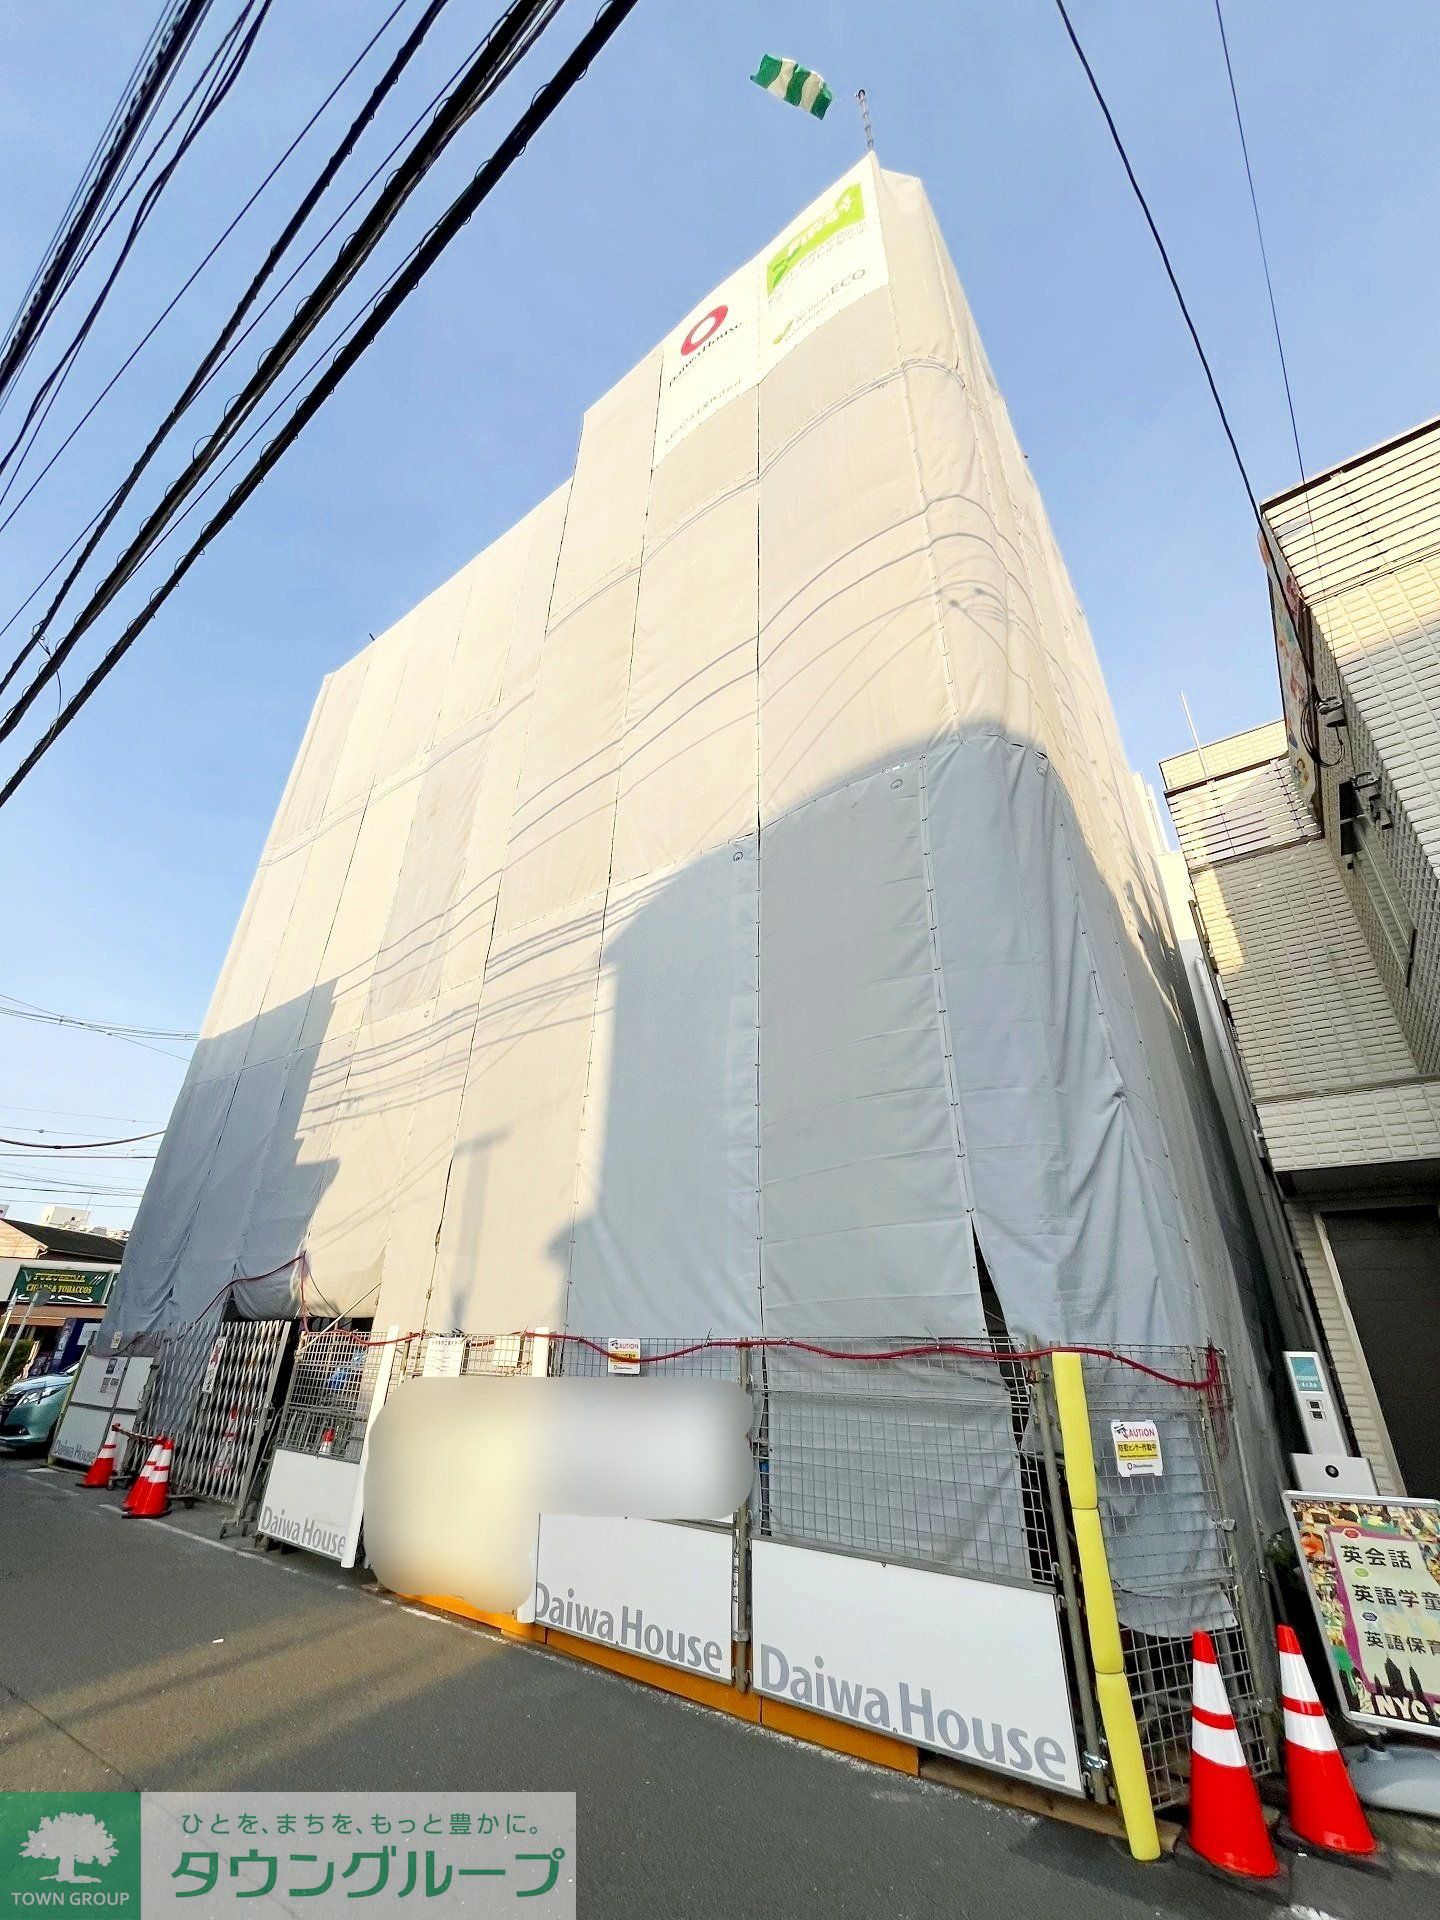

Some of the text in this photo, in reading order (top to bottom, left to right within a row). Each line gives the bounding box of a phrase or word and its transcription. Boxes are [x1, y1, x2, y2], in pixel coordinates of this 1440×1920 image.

[831, 269, 866, 294] ECO
[1123, 1428, 1155, 1438] CAUTION
[261, 1506, 346, 1556] Daiwa House
[1341, 1545, 1412, 1570] 英会話
[1352, 1584, 1440, 1611] 英語学童
[537, 1582, 722, 1673] Daiwa House
[761, 1644, 1066, 1782] Daiwa House
[1375, 1695, 1430, 1723] NYC
